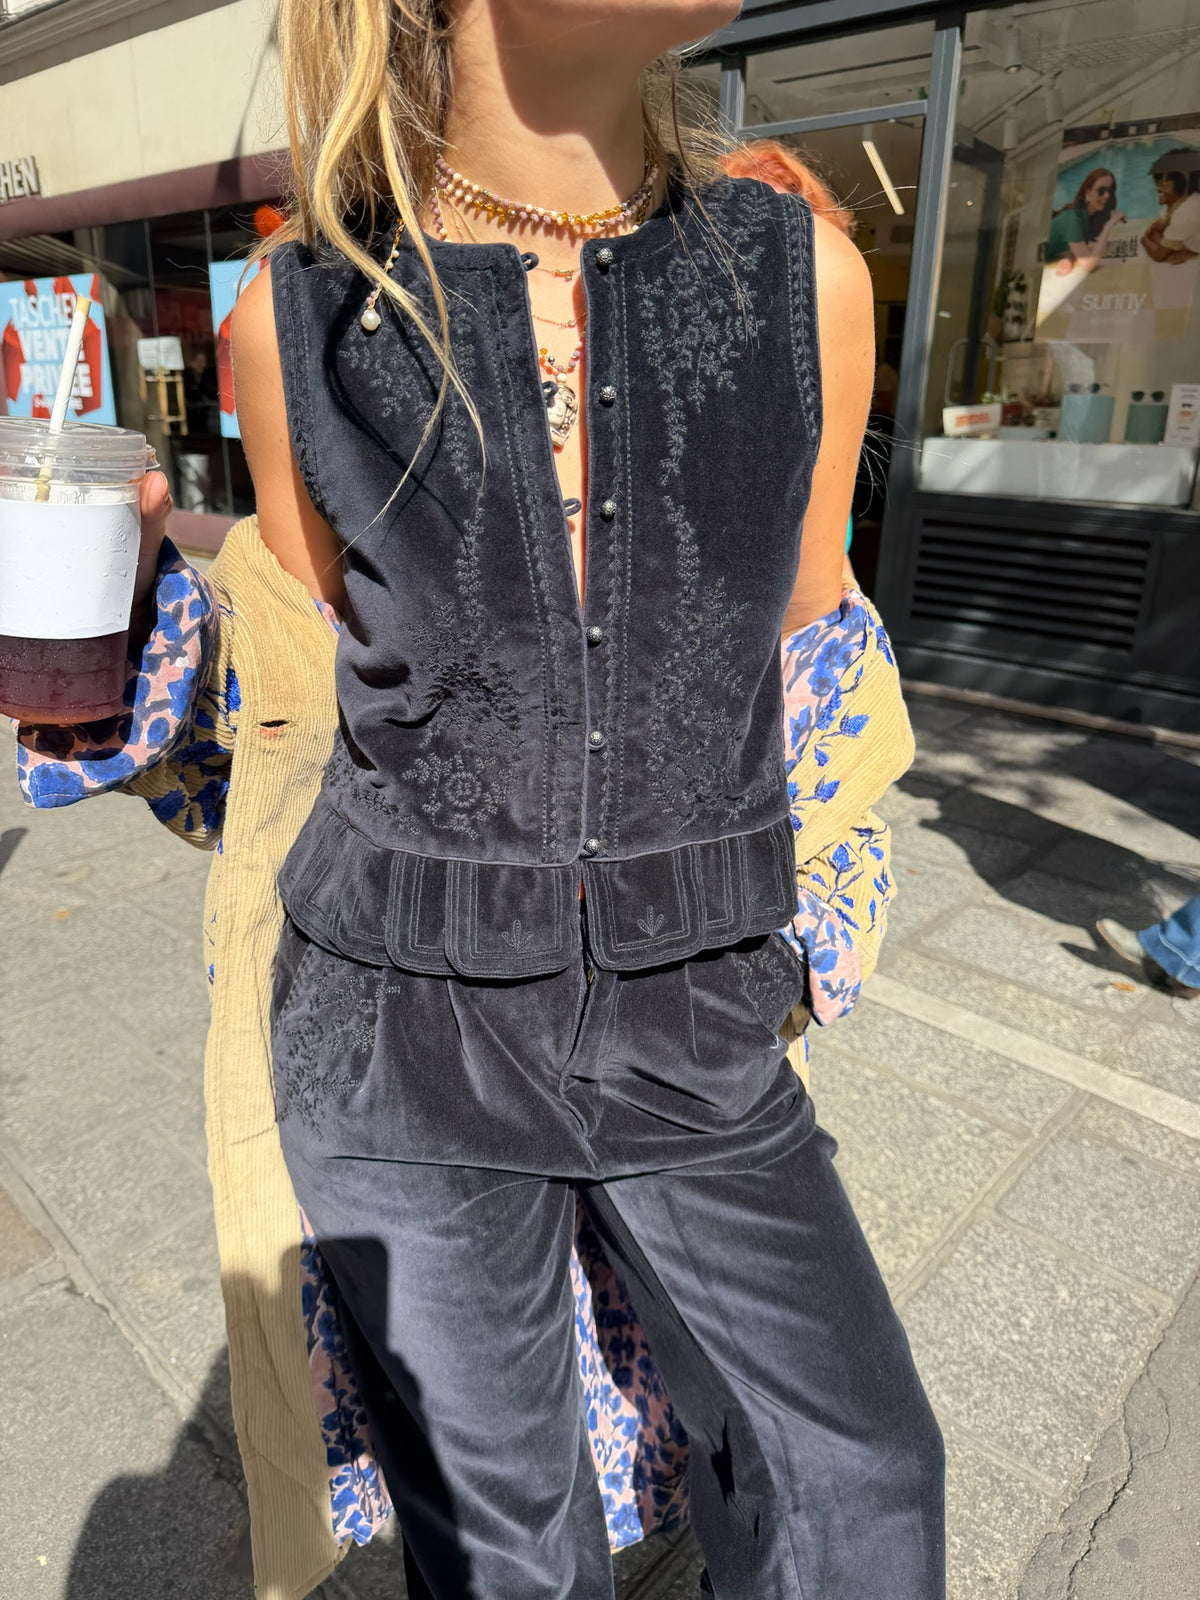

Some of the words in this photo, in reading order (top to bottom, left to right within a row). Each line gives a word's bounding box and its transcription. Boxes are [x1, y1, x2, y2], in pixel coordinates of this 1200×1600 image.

[8, 291, 78, 328] TASCHE
[1081, 292, 1147, 313] sunny
[18, 328, 85, 362] VENT
